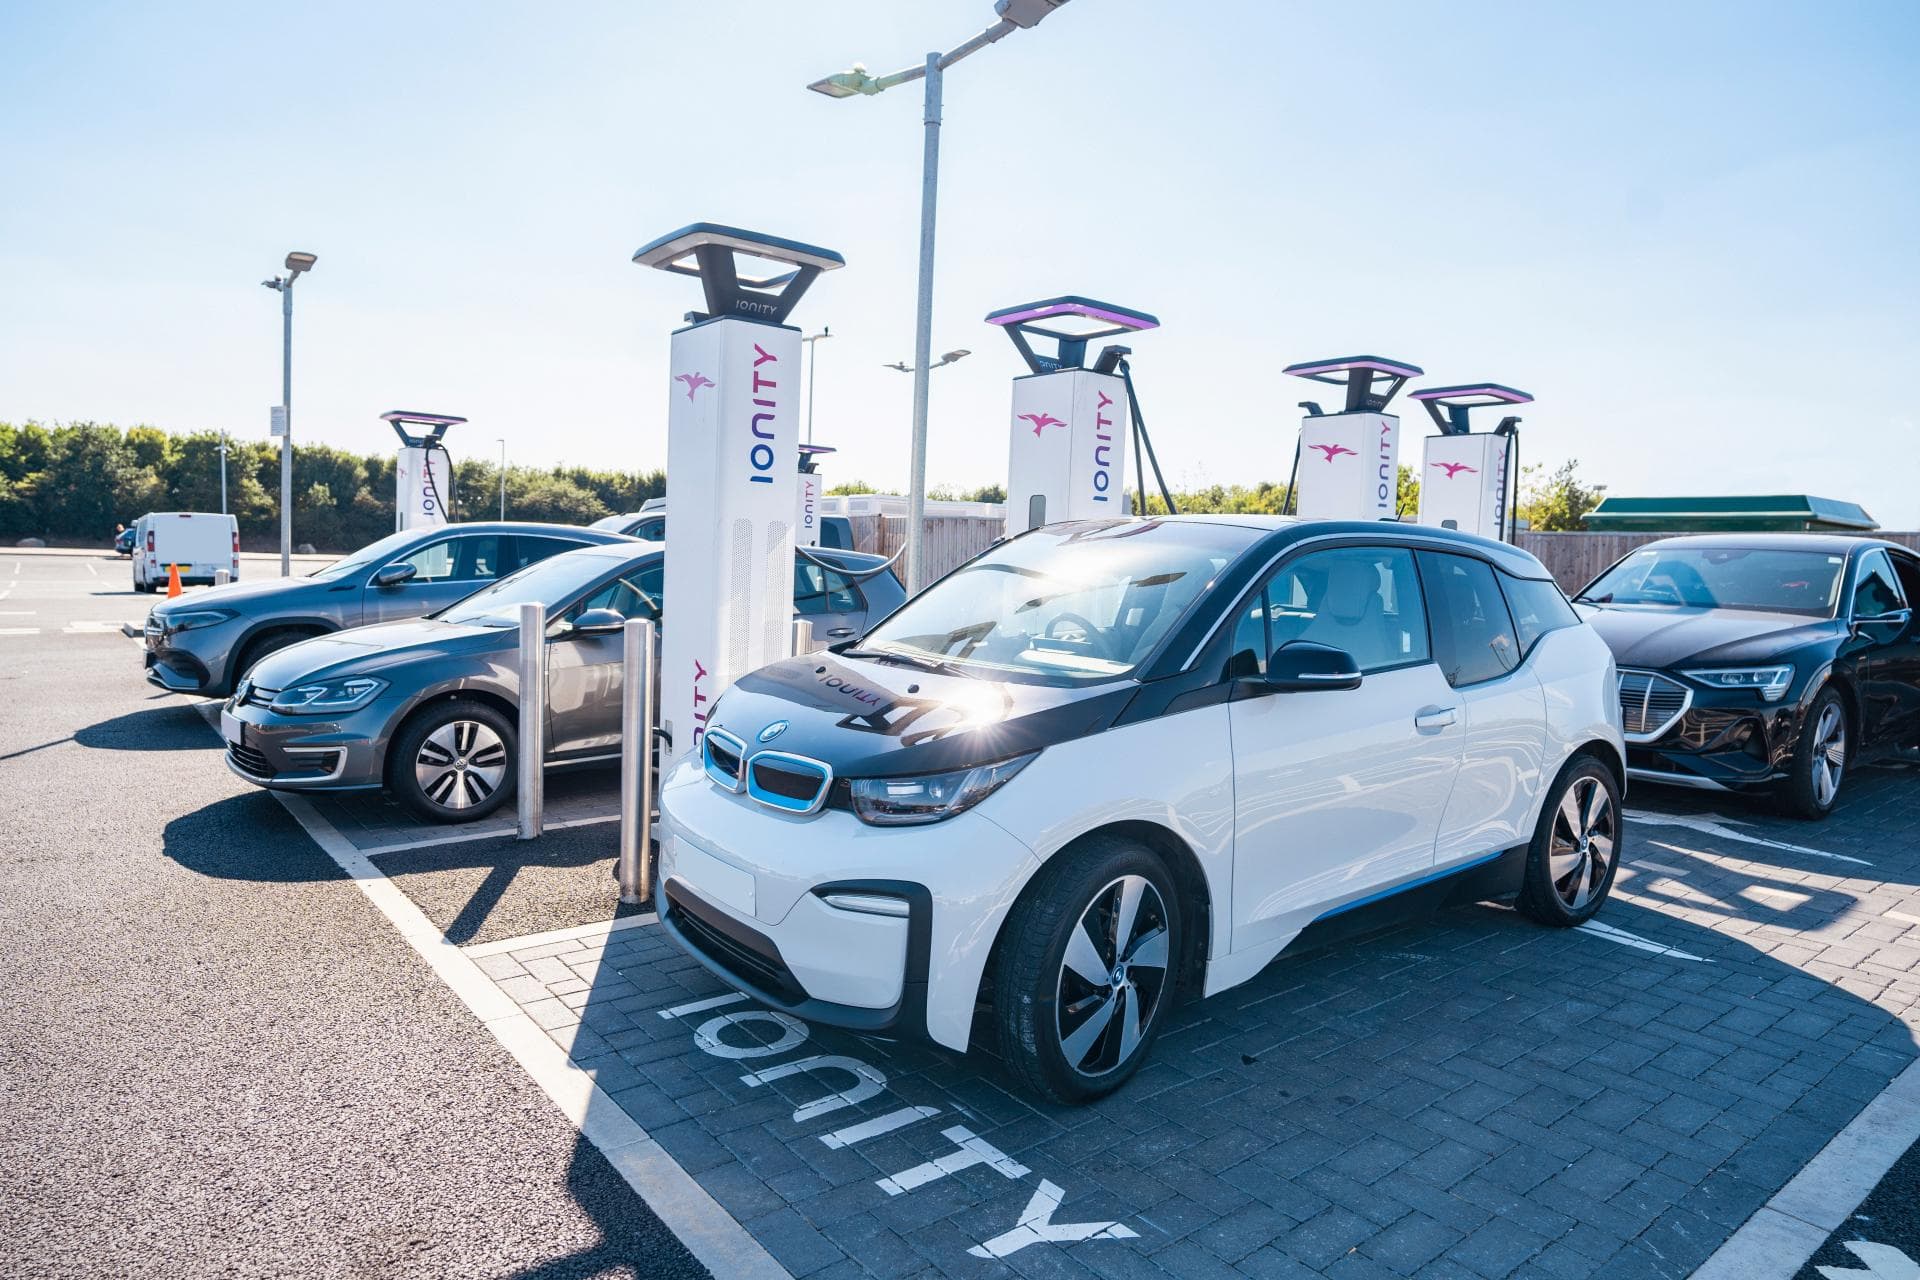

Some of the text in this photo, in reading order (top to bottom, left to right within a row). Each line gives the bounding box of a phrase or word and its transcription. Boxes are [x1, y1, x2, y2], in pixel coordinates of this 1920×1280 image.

[735, 299, 777, 315] IONITY
[750, 343, 777, 483] IONITY
[1092, 390, 1113, 502] IONITY
[804, 481, 814, 529] IONITY
[1378, 420, 1391, 508] IONITY
[657, 991, 1141, 1260] IONITY
